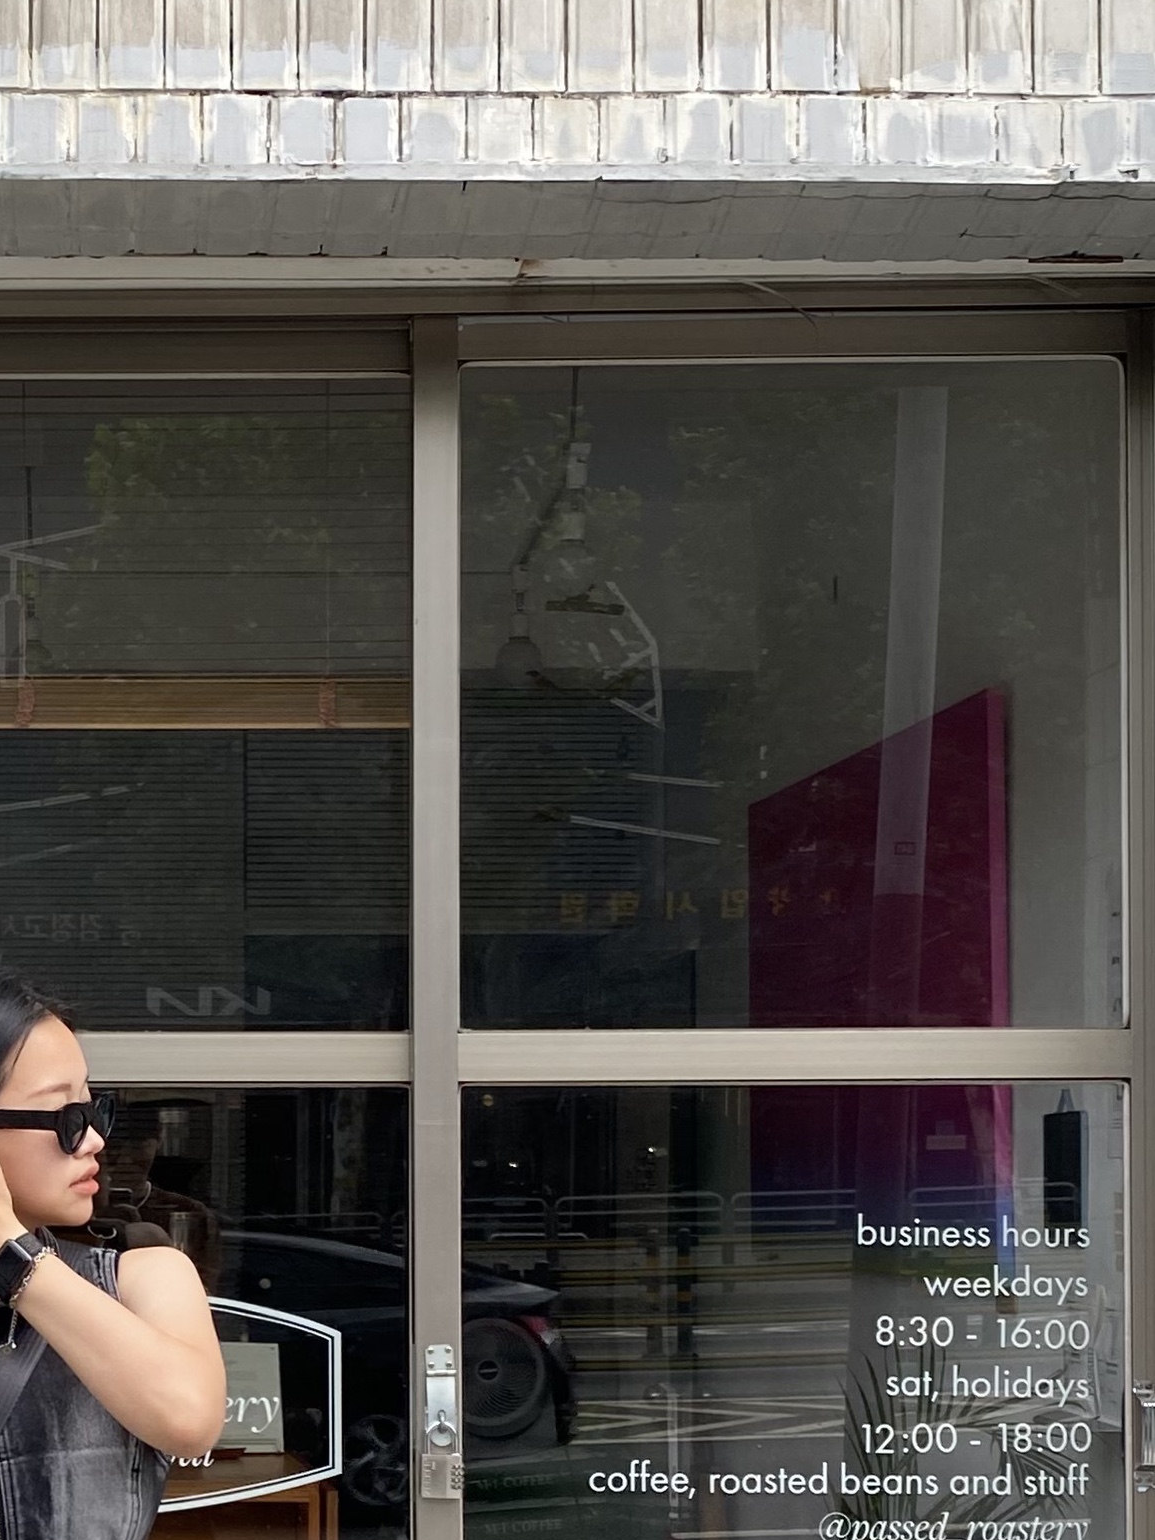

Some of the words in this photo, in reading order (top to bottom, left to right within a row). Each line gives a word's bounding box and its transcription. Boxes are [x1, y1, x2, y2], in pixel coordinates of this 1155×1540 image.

[856, 1212, 992, 1248] business
[1002, 1214, 1091, 1249] hours
[922, 1263, 1089, 1307] weekdays
[874, 1314, 955, 1348] 8:30
[995, 1316, 1091, 1351] 16:00
[885, 1370, 940, 1403] sat,
[951, 1363, 1090, 1408] holidays
[860, 1421, 959, 1455] 12:00
[996, 1421, 1093, 1454] 18:00
[588, 1458, 697, 1501] coffee,
[708, 1460, 829, 1496] roasted
[839, 1460, 940, 1496] beans
[948, 1462, 1013, 1497] and
[1023, 1462, 1090, 1497] stuff
[511, 1518, 563, 1534] COFFEE
